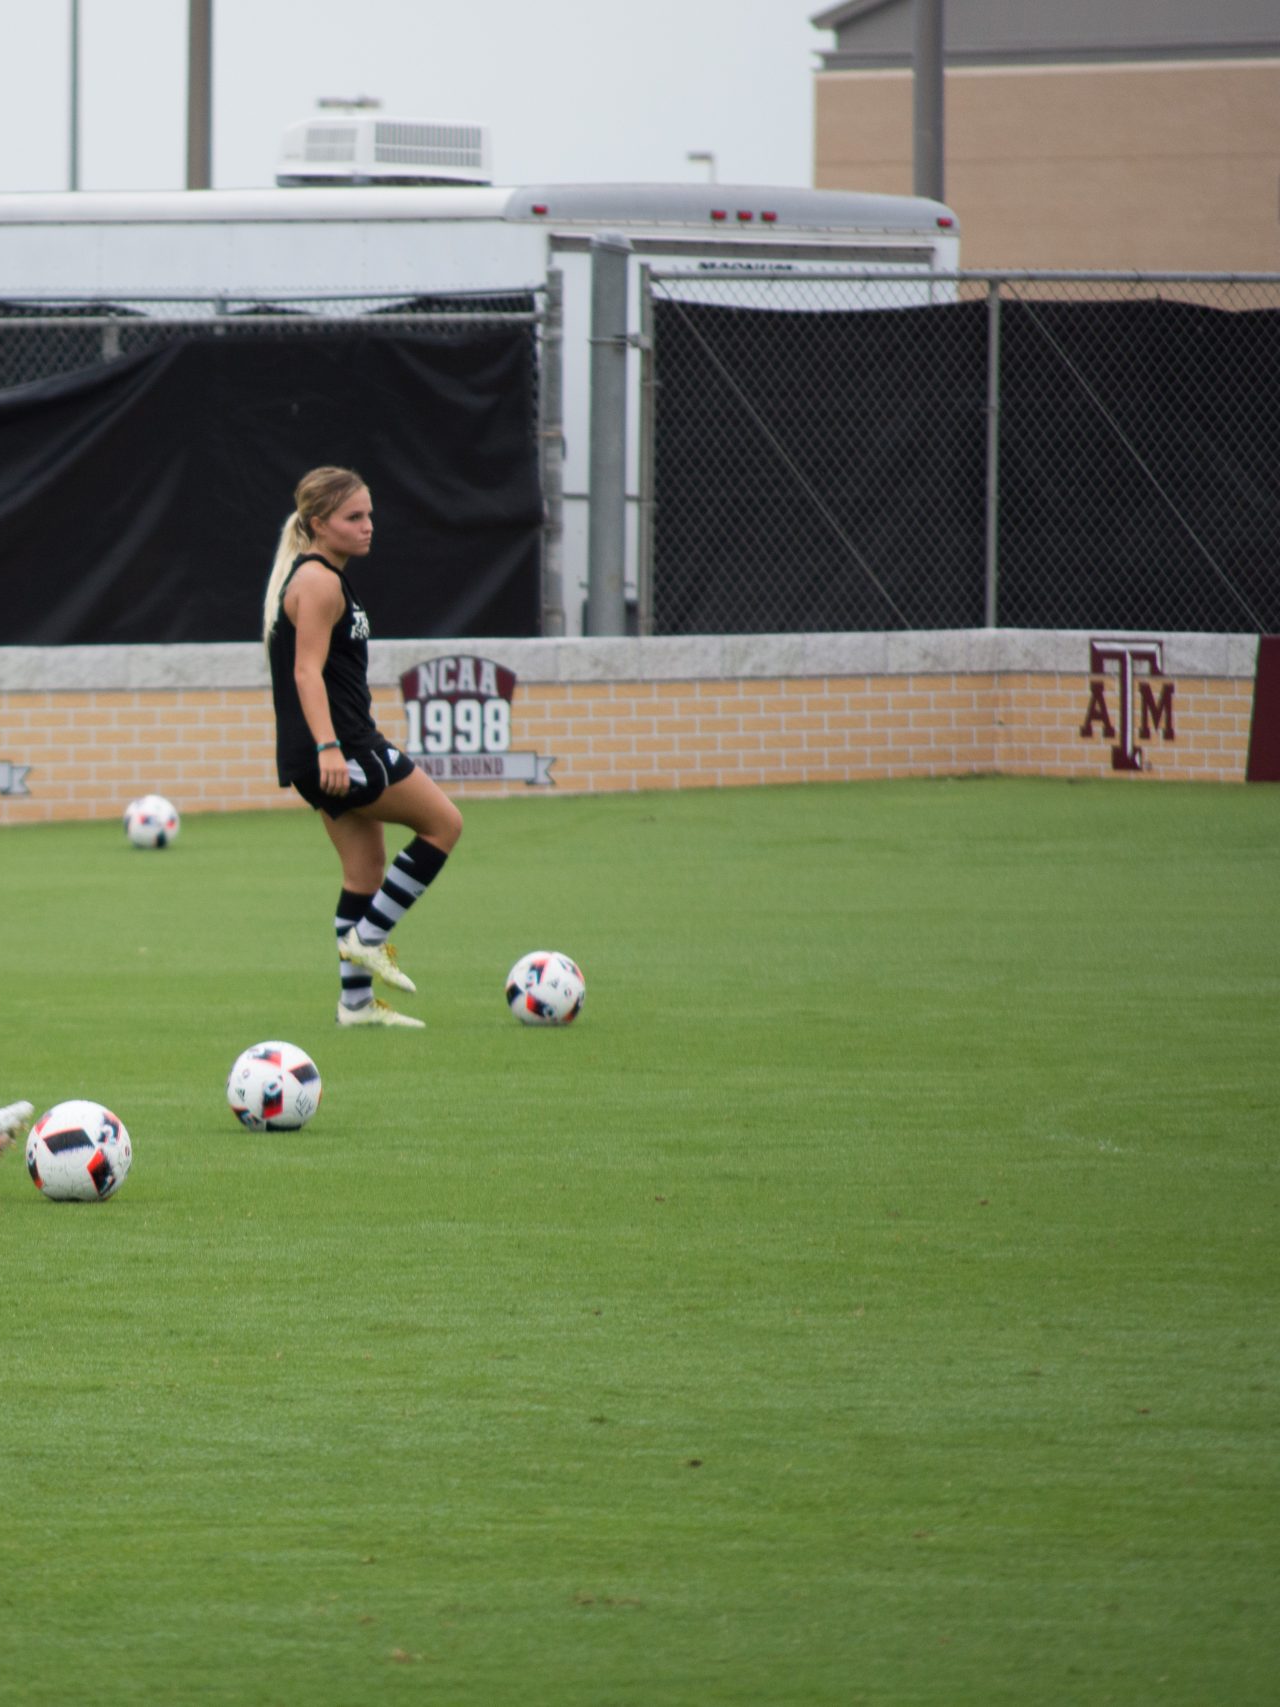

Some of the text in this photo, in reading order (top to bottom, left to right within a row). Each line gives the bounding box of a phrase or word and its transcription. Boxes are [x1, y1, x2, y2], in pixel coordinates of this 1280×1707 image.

[417, 657, 500, 698] NCAA
[405, 698, 512, 754] 1998
[450, 757, 504, 775] ROUND
